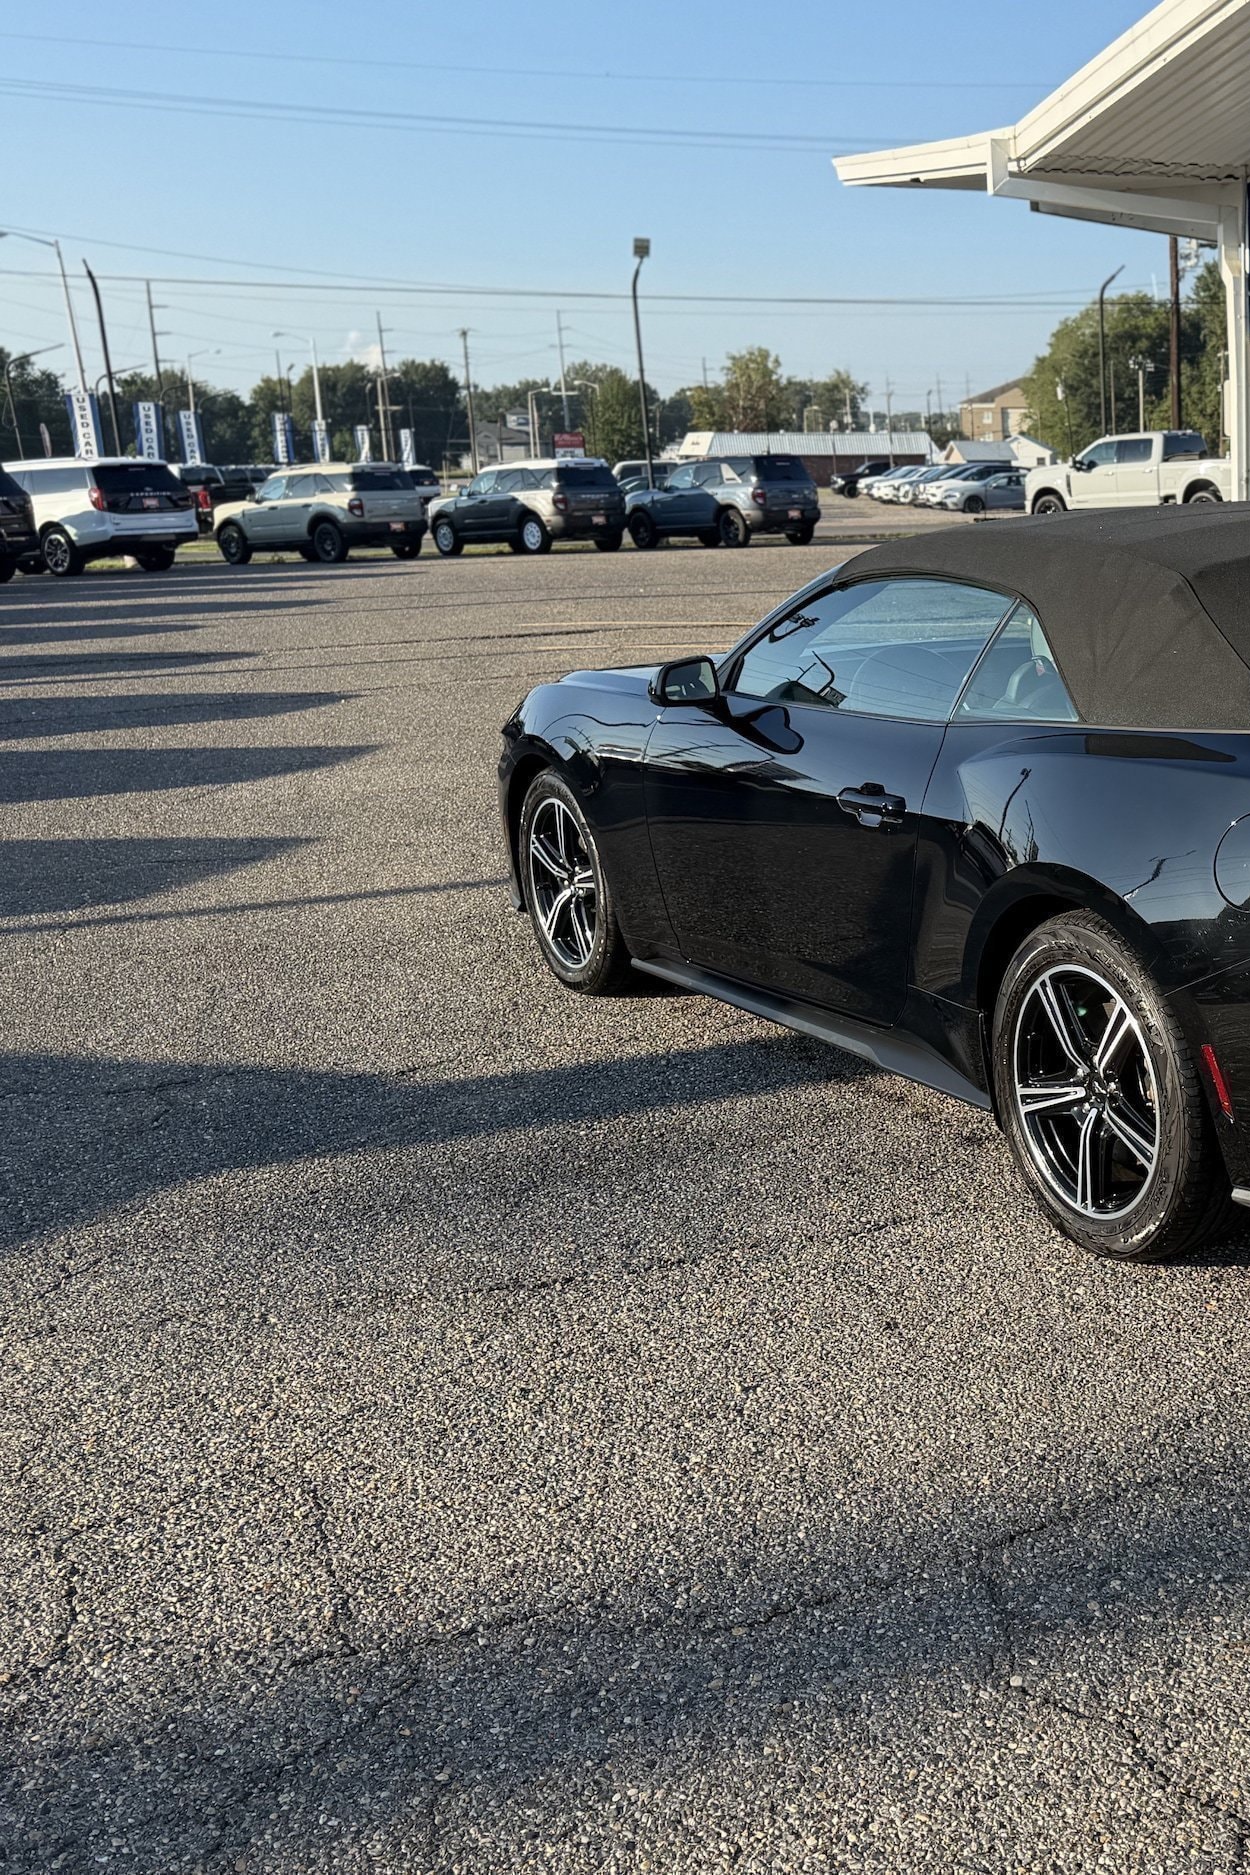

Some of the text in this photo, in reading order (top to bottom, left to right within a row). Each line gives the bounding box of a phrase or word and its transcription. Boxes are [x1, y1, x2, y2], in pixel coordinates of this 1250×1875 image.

[76, 397, 90, 428] USED
[142, 406, 153, 433] USED
[183, 413, 194, 439] USED
